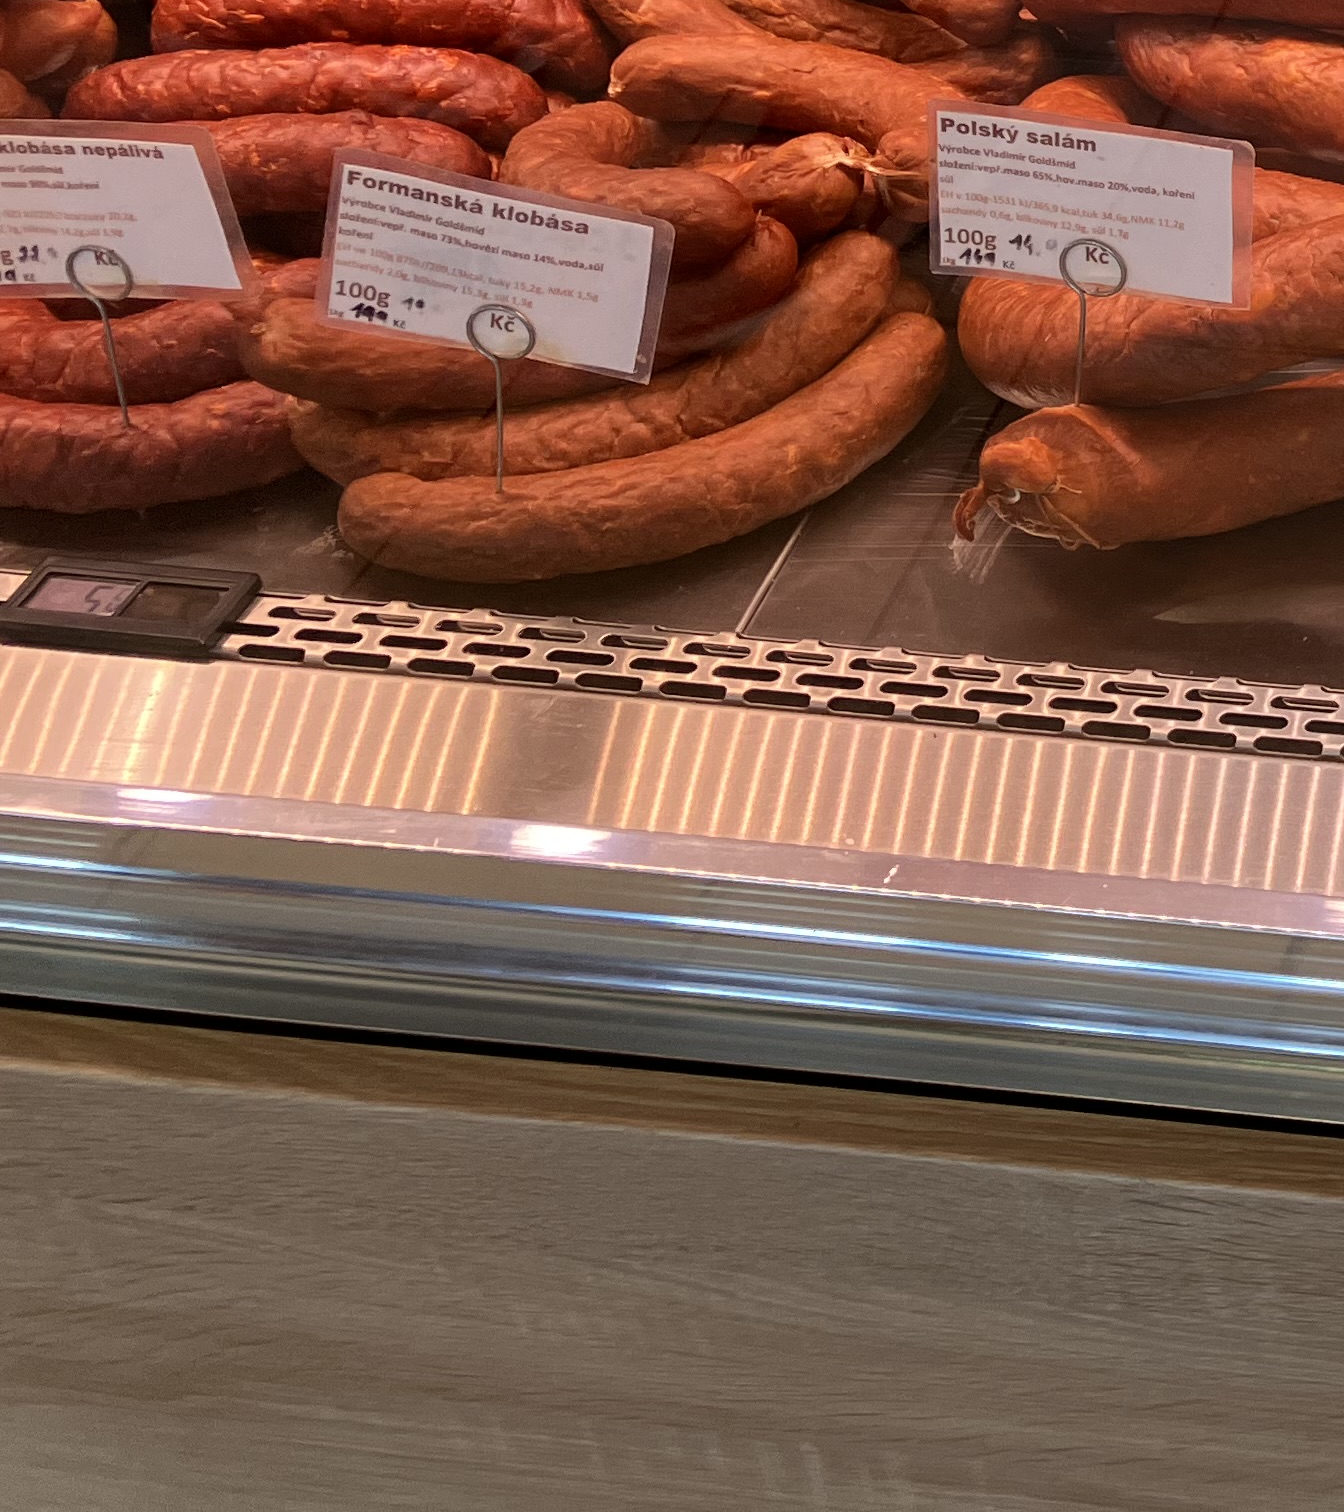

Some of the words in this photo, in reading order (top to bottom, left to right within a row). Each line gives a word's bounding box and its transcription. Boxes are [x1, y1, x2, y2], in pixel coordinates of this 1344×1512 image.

[82, 144, 165, 160] nepálivá
[940, 117, 1019, 144] Polský
[1027, 131, 1097, 152] salám
[346, 170, 484, 215] Formanská
[491, 201, 589, 235] klobása
[944, 227, 997, 251] 100g
[1085, 246, 1110, 265] Kč
[335, 279, 391, 308] 100g
[489, 311, 516, 334] Kč
